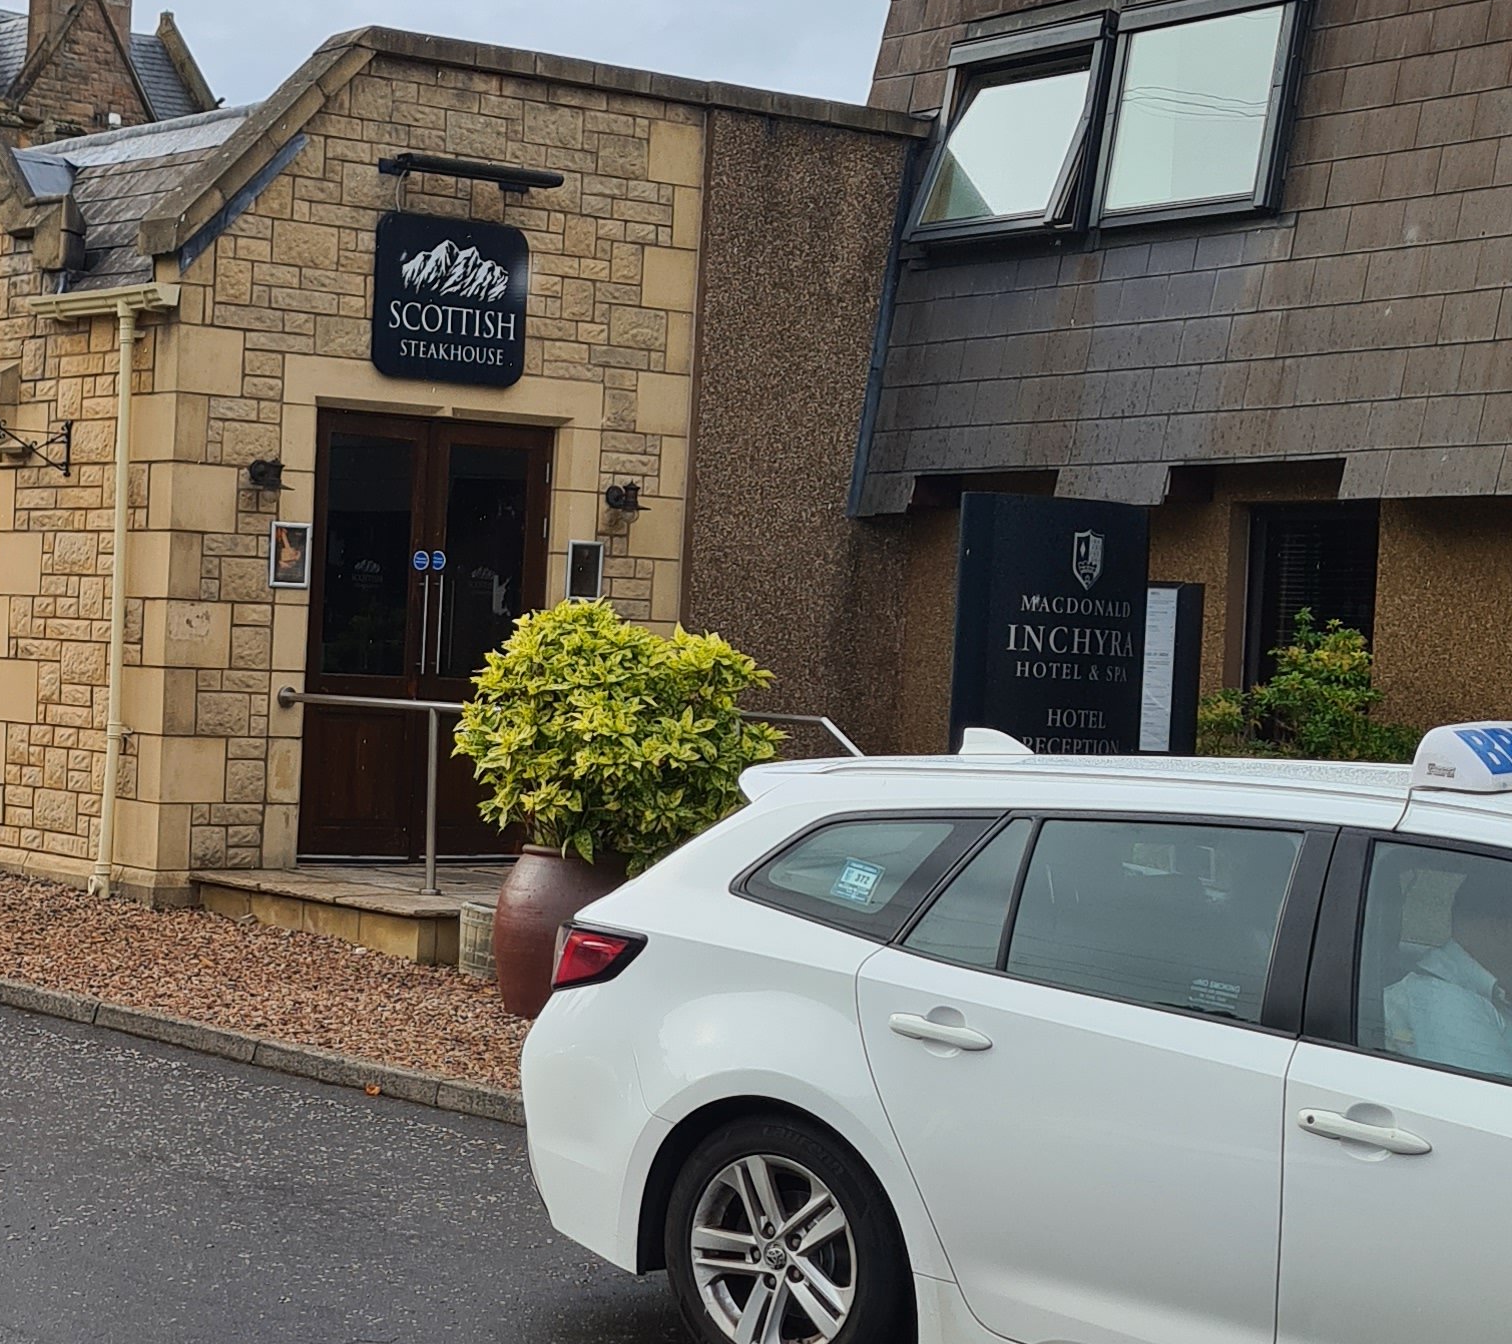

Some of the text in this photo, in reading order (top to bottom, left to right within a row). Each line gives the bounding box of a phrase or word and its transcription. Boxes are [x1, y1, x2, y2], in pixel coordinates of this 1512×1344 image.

[388, 300, 516, 341] SCOTTISH
[399, 339, 504, 366] STEAKHOUSE
[1020, 595, 1131, 618] MACDONALD
[1006, 623, 1134, 657] INCHYRA
[1016, 661, 1128, 682] HOTEL & SPA
[1046, 708, 1106, 729] HOTEL
